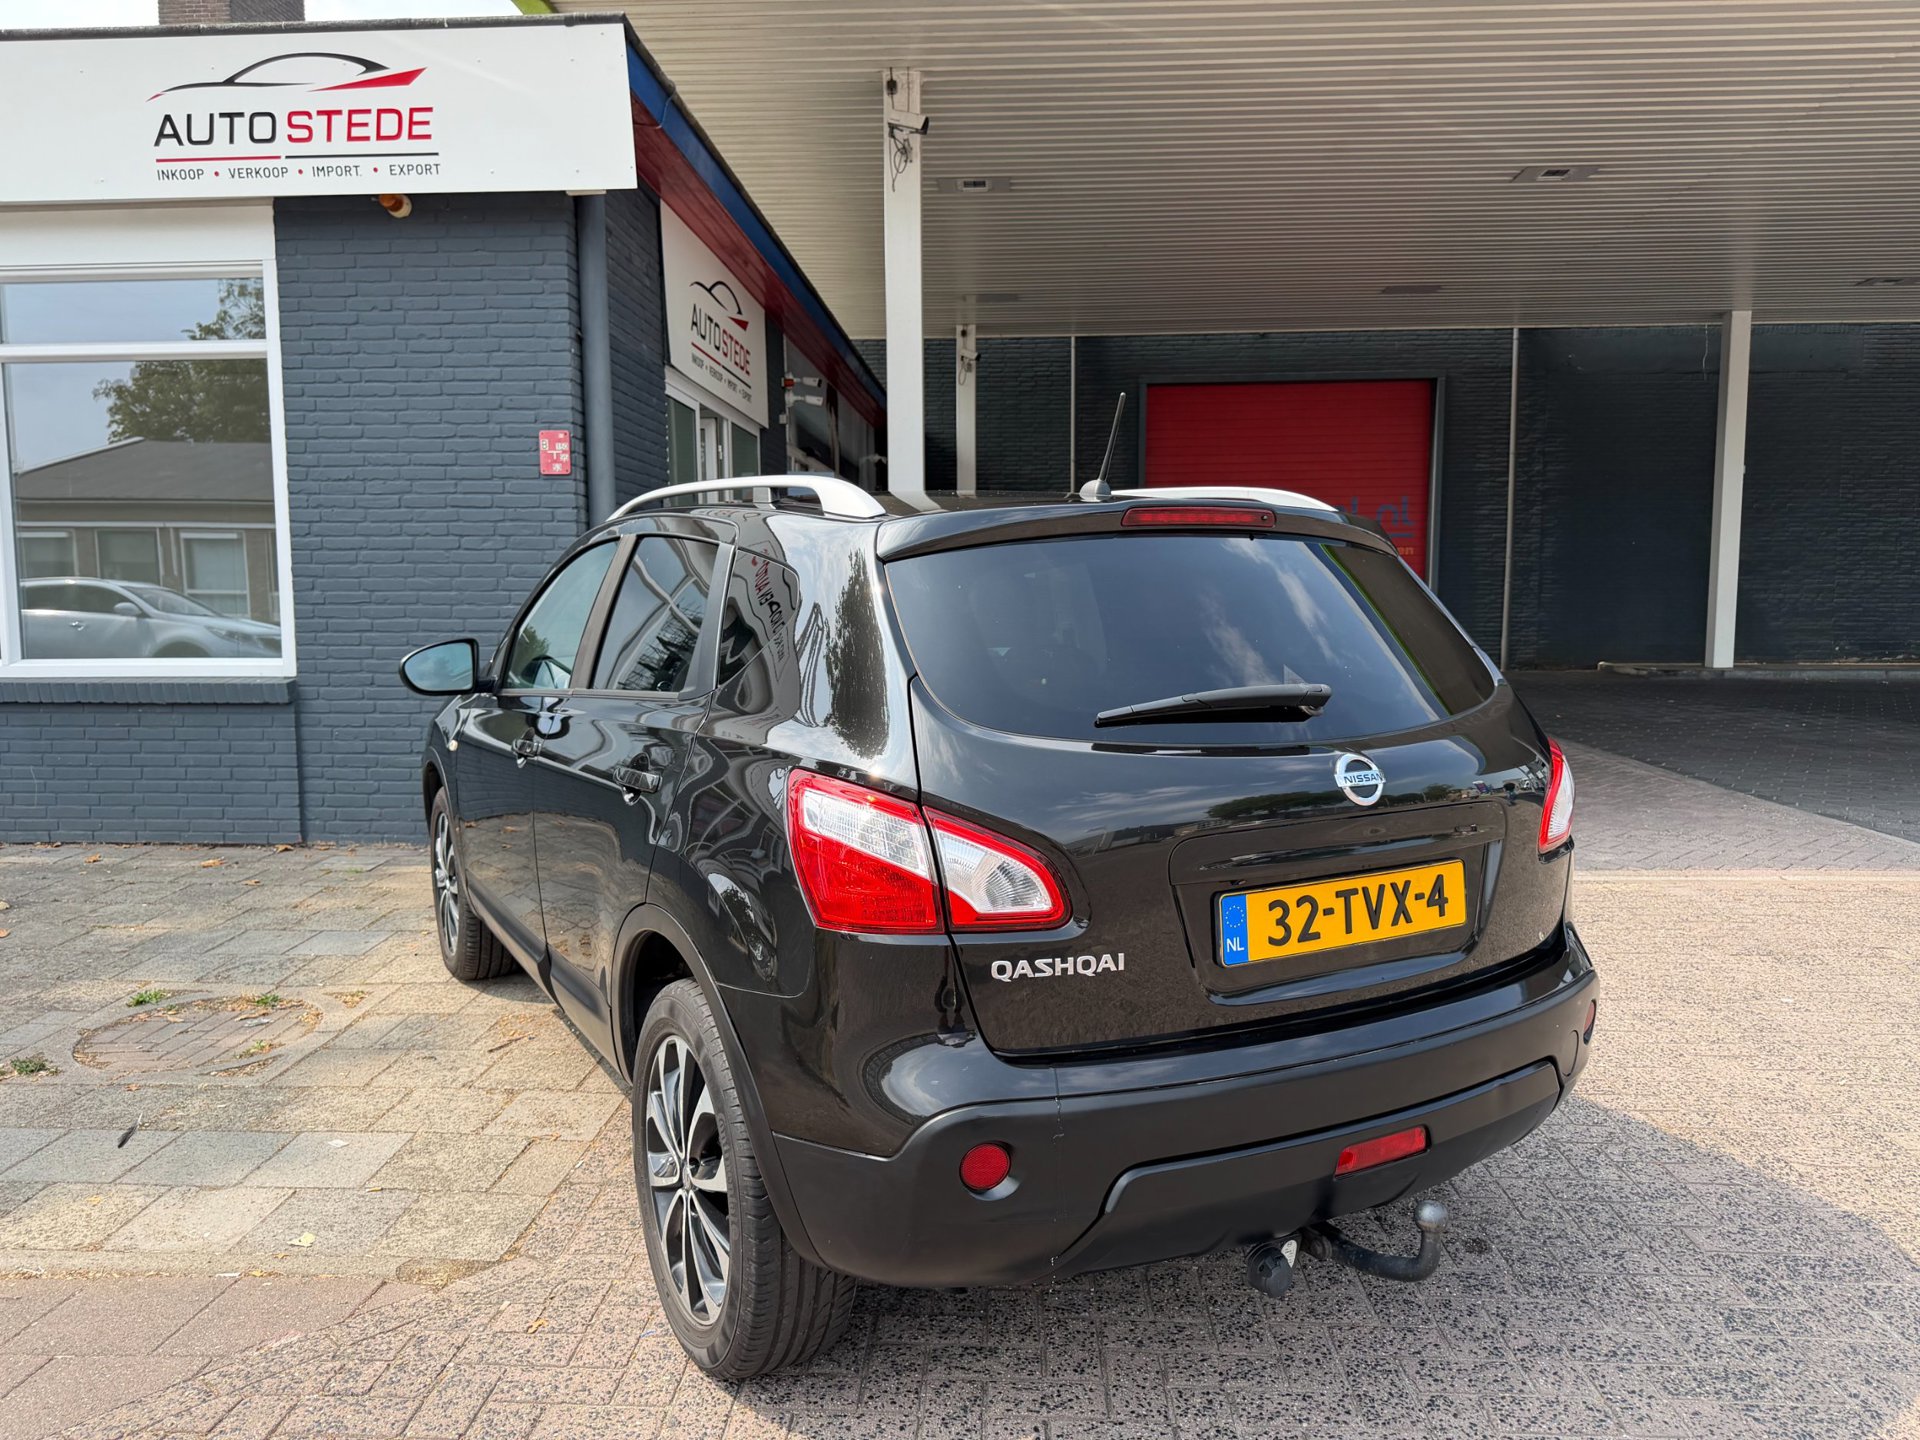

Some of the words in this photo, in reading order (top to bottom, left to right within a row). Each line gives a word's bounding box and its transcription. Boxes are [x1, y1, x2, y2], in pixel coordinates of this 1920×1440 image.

[157, 168, 205, 181] INKOOP
[228, 166, 289, 179] VERKOOP
[389, 163, 441, 176] EXPORT
[1343, 772, 1383, 784] NISSAN
[1267, 873, 1449, 947] 32-TVX-4
[1226, 937, 1245, 953] NL
[990, 952, 1126, 983] QASHQAI
